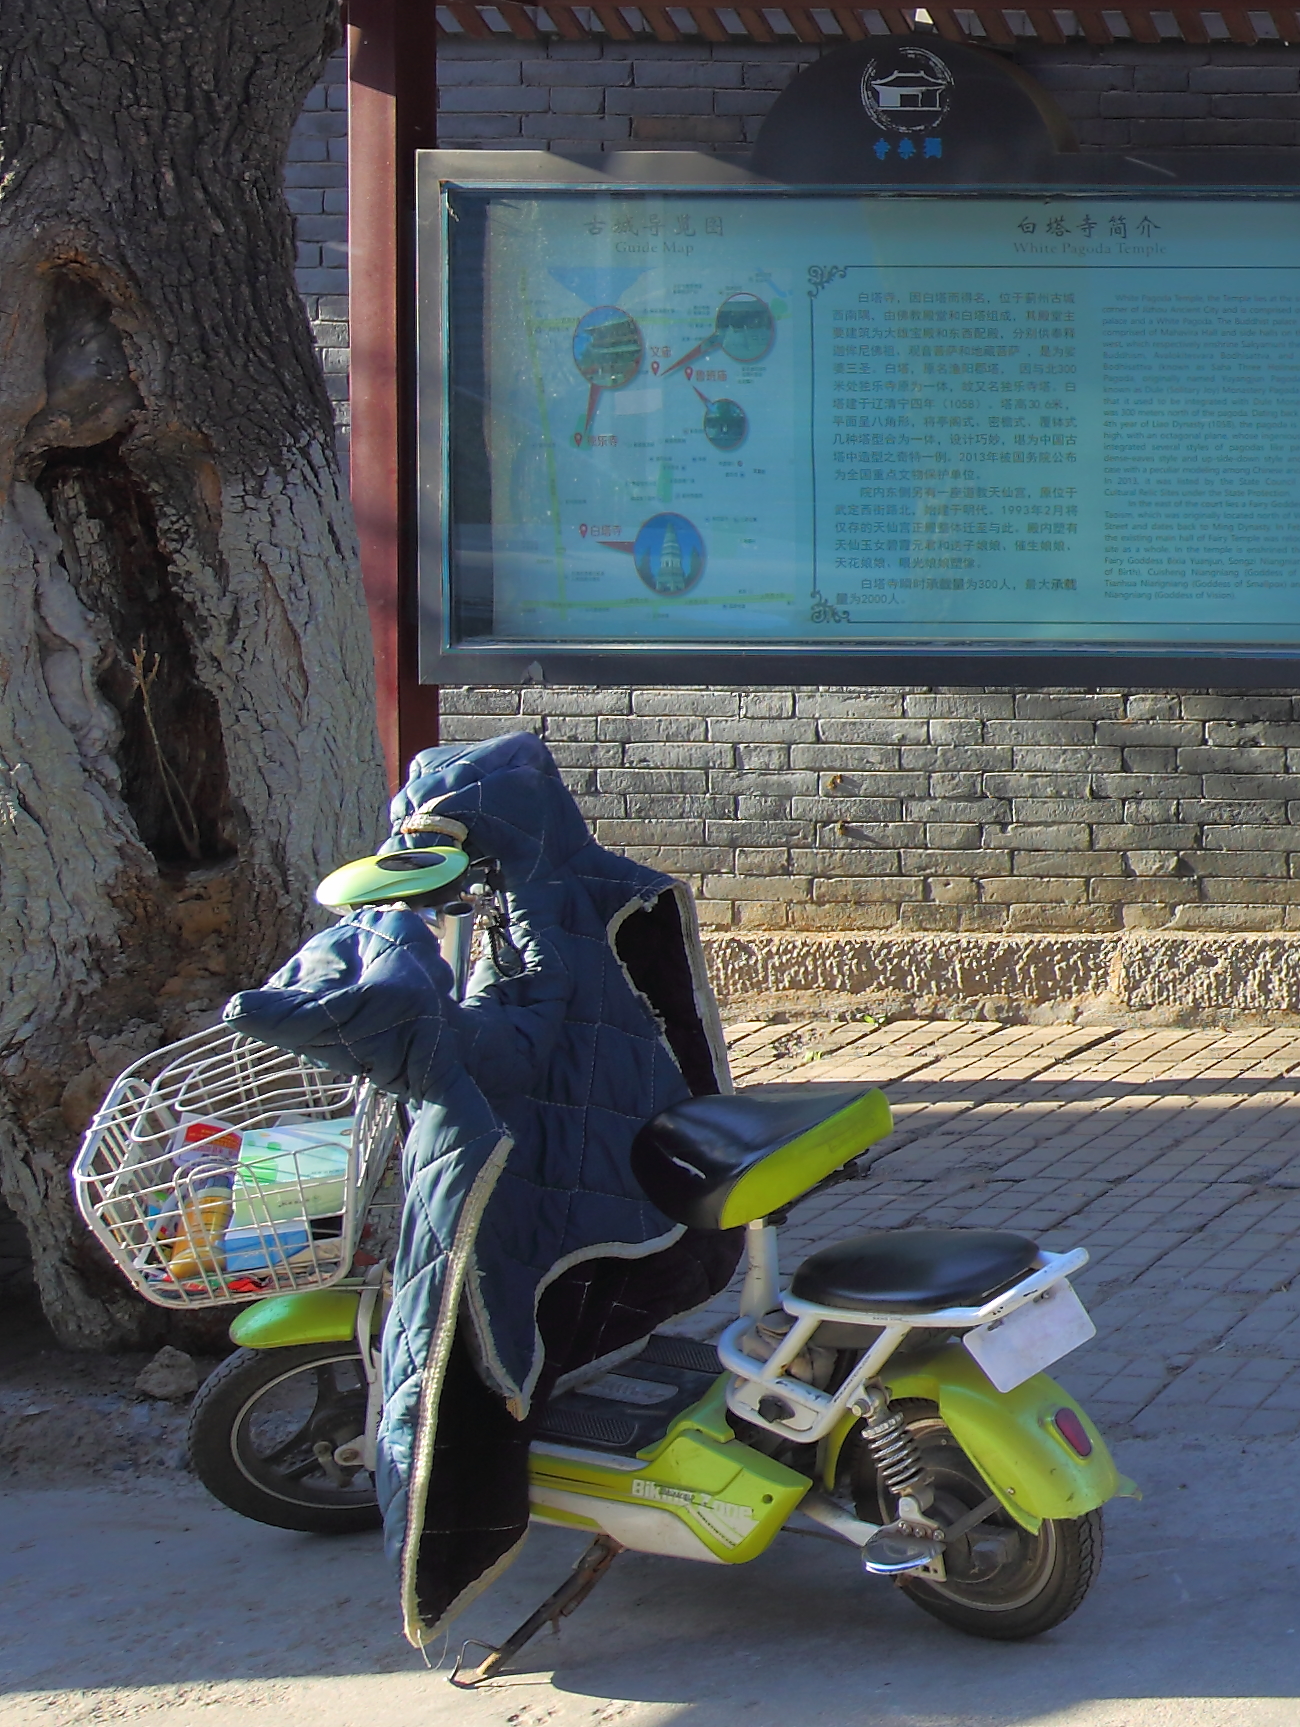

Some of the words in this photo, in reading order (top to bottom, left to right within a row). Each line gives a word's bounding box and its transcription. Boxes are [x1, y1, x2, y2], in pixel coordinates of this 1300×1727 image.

[583, 214, 726, 237] 古城导览图
[1016, 214, 1162, 238] 白塔寺简介
[615, 241, 659, 255] Guide
[662, 241, 694, 256] Map
[1013, 240, 1057, 255] White
[1061, 240, 1112, 258] Pagoda
[1116, 240, 1168, 258] Temple
[650, 345, 672, 359] 文庙
[834, 469, 980, 481] 为全国重点文物保护单位。
[590, 525, 622, 537] 白塔寺
